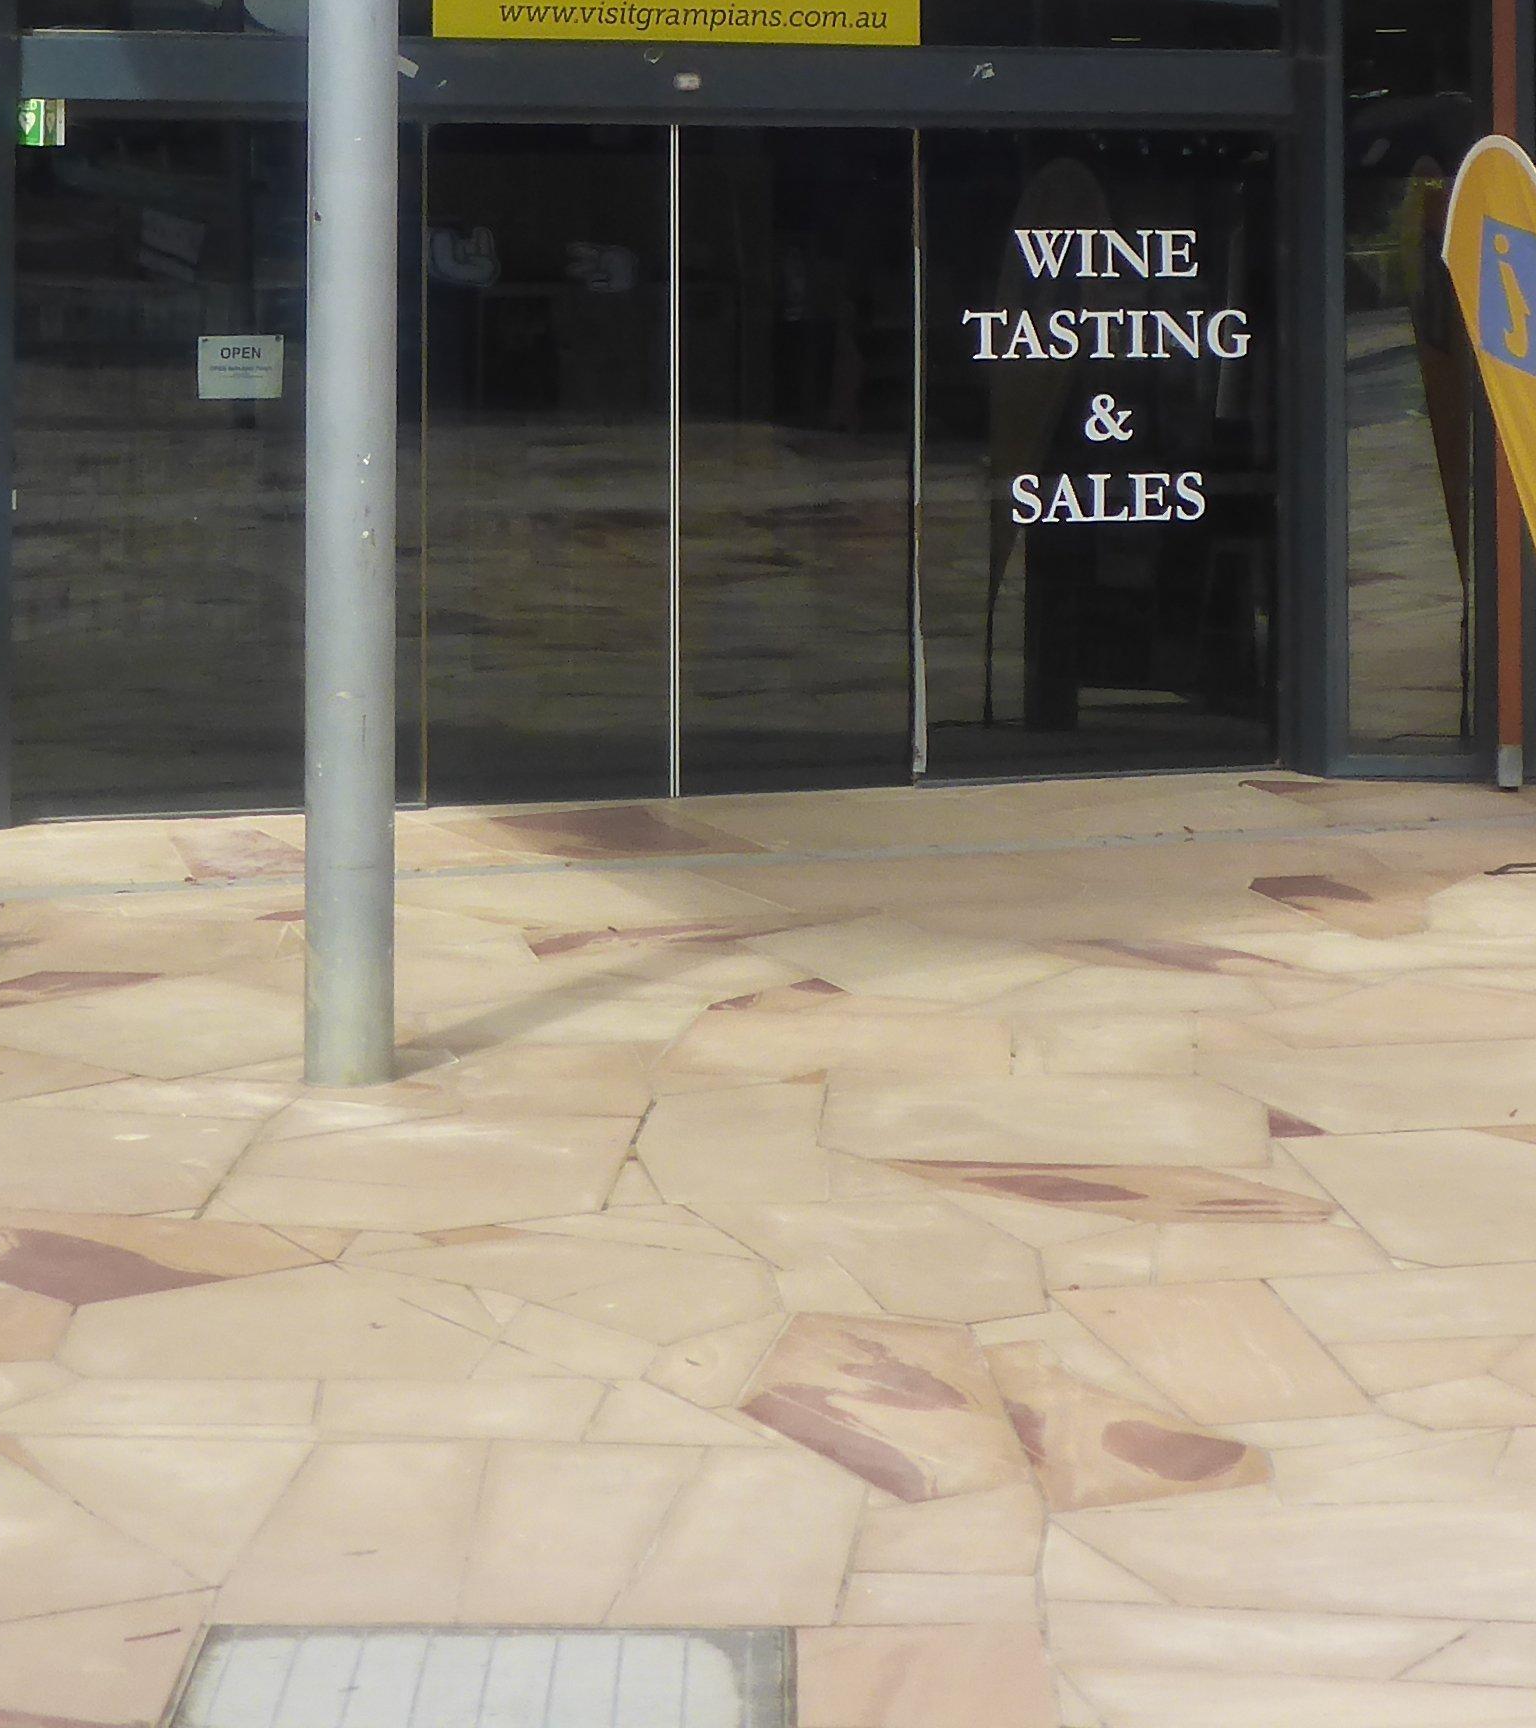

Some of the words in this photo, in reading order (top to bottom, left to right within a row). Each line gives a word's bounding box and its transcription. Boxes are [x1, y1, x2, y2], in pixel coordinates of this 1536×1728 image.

[498, 0, 888, 31] www.visitgrampians.com.au
[1014, 229, 1199, 278] WINE
[220, 346, 261, 360] OPEN
[962, 309, 1252, 360] TASTING
[1084, 393, 1134, 442] &
[1011, 472, 1206, 524] SALES
